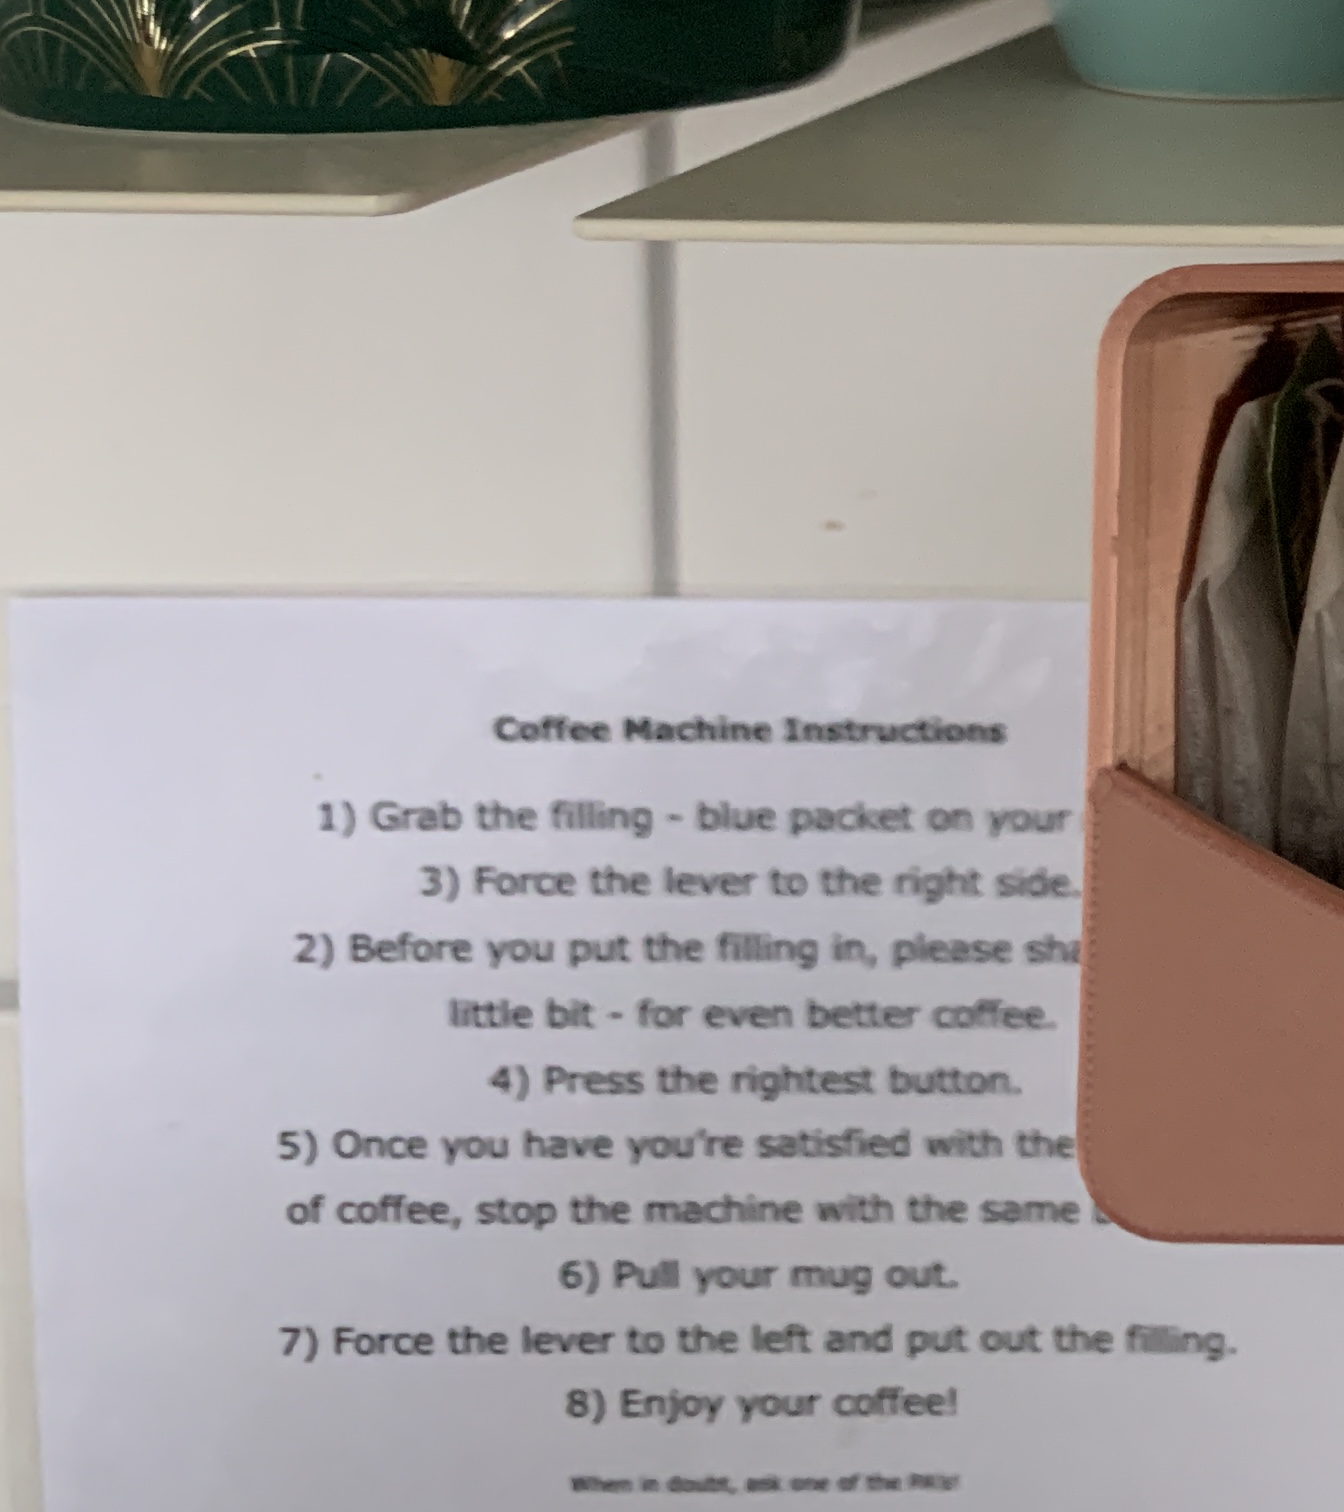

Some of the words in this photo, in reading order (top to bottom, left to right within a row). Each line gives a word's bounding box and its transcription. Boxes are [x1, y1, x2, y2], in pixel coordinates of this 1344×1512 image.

[491, 715, 612, 743] Coffee
[621, 715, 773, 744] Machine
[782, 717, 1008, 745] Instructions
[318, 800, 356, 838] 1)
[369, 800, 463, 832] Grab
[475, 800, 538, 831] the
[549, 799, 653, 839] filling
[696, 801, 776, 832] blue
[788, 802, 914, 837] packet
[926, 808, 973, 833] on
[986, 809, 1072, 838] your
[420, 865, 460, 903] 3)
[473, 866, 577, 897] Force
[588, 865, 651, 896] the
[663, 866, 758, 897] lever
[768, 868, 808, 897] to
[818, 866, 882, 897] the
[893, 866, 983, 905] right
[995, 867, 1081, 898] side.
[293, 933, 334, 970] 2)
[348, 931, 473, 963] Before
[485, 938, 554, 969] you
[568, 935, 632, 968] put
[642, 932, 704, 963] the
[715, 932, 819, 971] filling
[831, 934, 877, 968] in,
[891, 933, 1013, 969] please
[1023, 934, 1081, 964] sha
[448, 998, 533, 1029] little
[545, 997, 595, 1029] bit
[636, 998, 692, 1029] for
[702, 1005, 793, 1030] even
[806, 998, 921, 1029] better
[931, 999, 1056, 1030] coffee.
[488, 1065, 529, 1101] 4)
[543, 1065, 645, 1095] Press
[656, 1064, 718, 1095] the
[731, 1064, 875, 1102] rightest
[888, 1065, 1022, 1096] button.
[277, 1129, 319, 1166] 5)
[332, 1129, 428, 1160] Once
[440, 1136, 509, 1166] you
[522, 1129, 614, 1160] have
[755, 1127, 911, 1159] satisfied
[924, 1129, 1003, 1159] with
[1015, 1129, 1076, 1160] the
[286, 1194, 326, 1225] of
[335, 1193, 462, 1230] coffee,
[475, 1198, 557, 1231] stop
[568, 1194, 631, 1225] the
[643, 1194, 803, 1224] machine
[815, 1193, 894, 1224] with
[906, 1194, 968, 1224] the
[979, 1200, 1081, 1225] same
[558, 1260, 600, 1296] 6)
[613, 1259, 680, 1290] Pull
[693, 1266, 778, 1295] your
[789, 1265, 873, 1296] mug
[885, 1261, 958, 1289] out.
[279, 1326, 319, 1363] 7)
[333, 1326, 435, 1356] Force
[447, 1326, 509, 1355] the
[521, 1325, 615, 1355] lever
[625, 1326, 665, 1355] to
[676, 1324, 739, 1354] the
[751, 1323, 812, 1354] left
[823, 1323, 893, 1353] and
[906, 1325, 969, 1360] put
[980, 1326, 1042, 1354] out
[1052, 1324, 1114, 1354] the
[1125, 1324, 1237, 1363] filling.
[565, 1389, 607, 1425] 8)
[620, 1388, 725, 1425] Enjoy
[735, 1393, 822, 1424] your
[832, 1386, 957, 1419] coffee!
